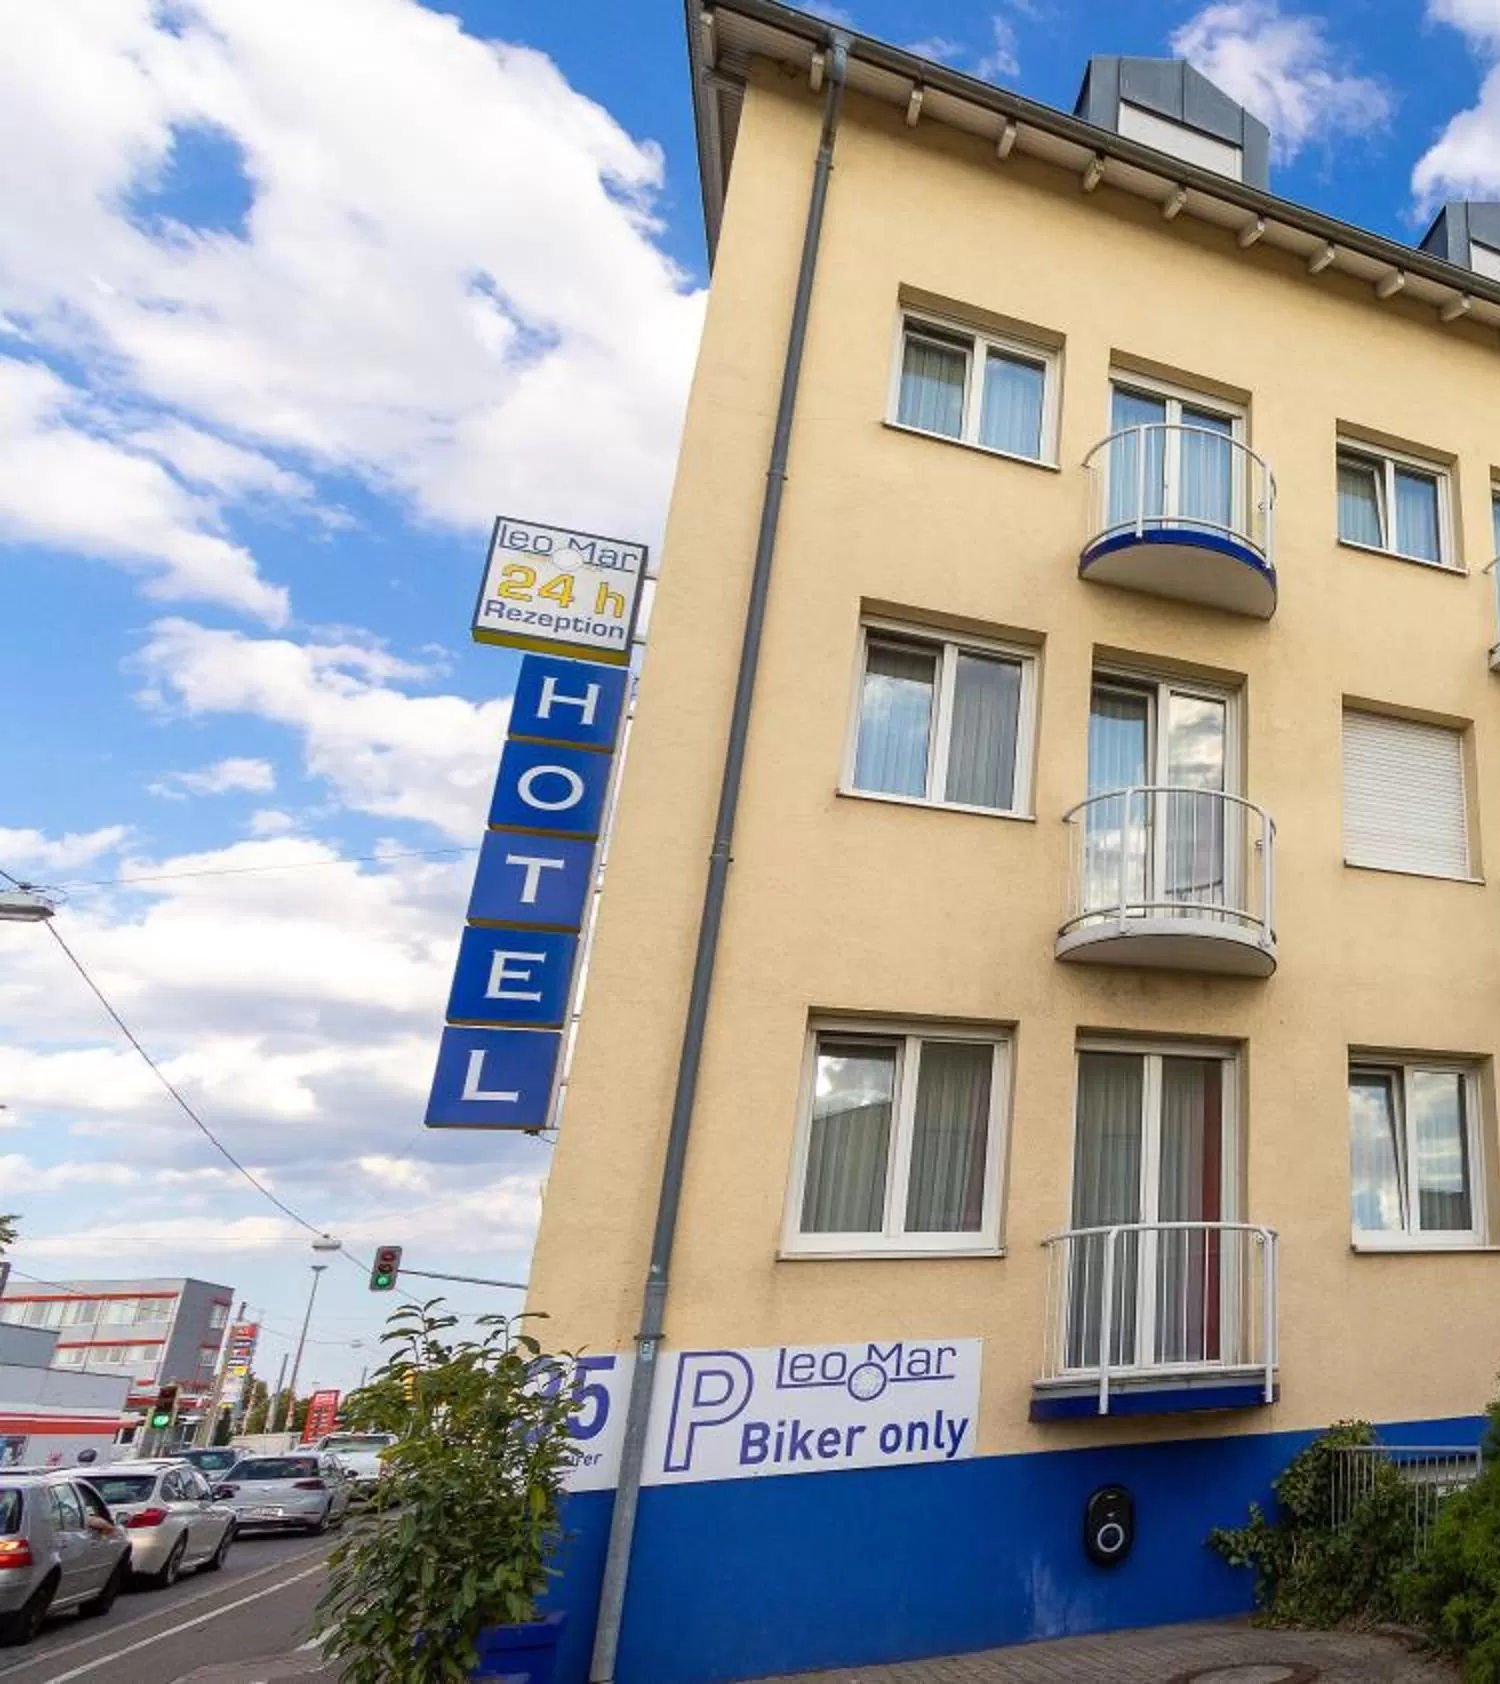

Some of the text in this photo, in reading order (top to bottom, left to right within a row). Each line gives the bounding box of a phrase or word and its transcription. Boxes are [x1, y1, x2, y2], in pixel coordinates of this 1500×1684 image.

[568, 537, 638, 572] Mar
[497, 563, 625, 619] 24 h
[484, 600, 625, 640] Rezeption
[462, 676, 602, 1103] HOTEL
[663, 1350, 755, 1473] P
[738, 1409, 970, 1466] Biker only
